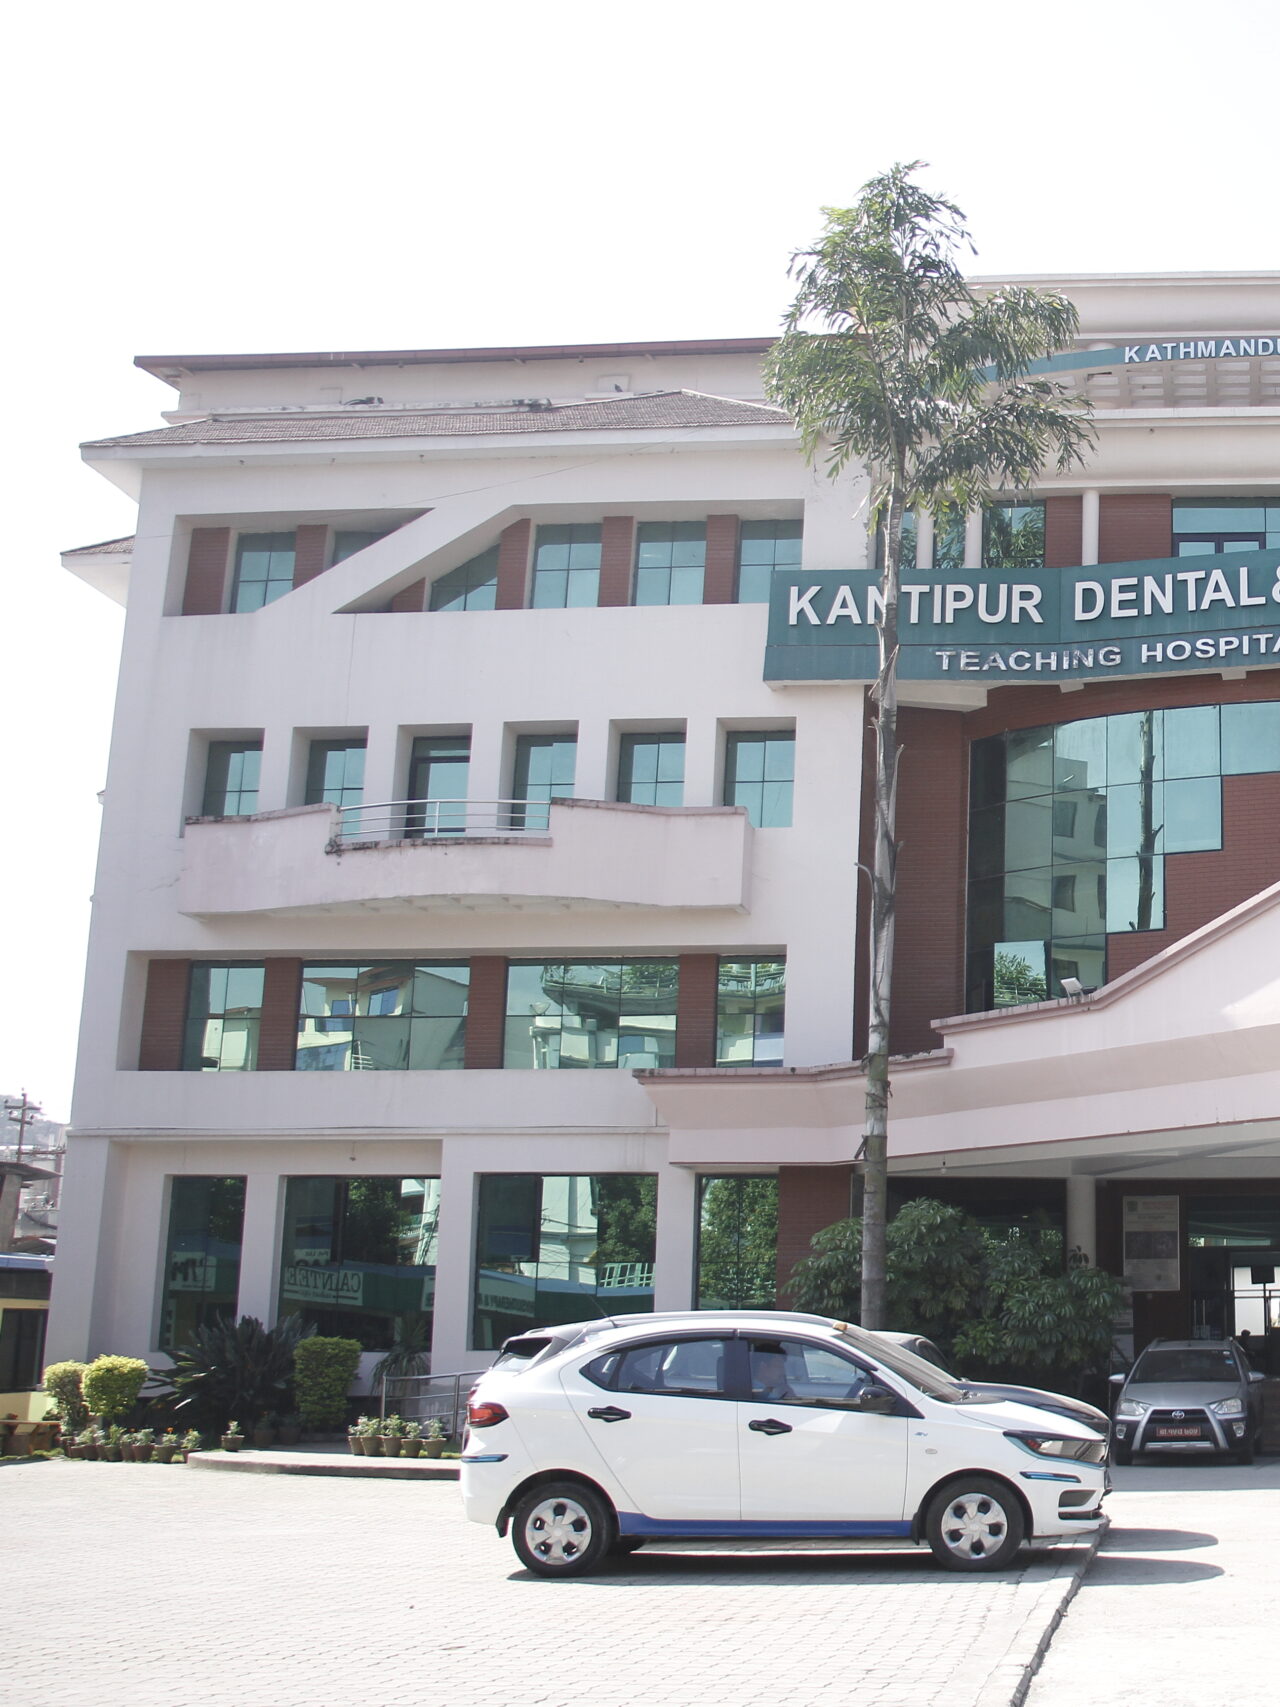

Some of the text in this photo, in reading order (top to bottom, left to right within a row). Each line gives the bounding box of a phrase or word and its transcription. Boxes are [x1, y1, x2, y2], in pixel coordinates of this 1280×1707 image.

[788, 583, 1044, 626] KANTIPUR
[1074, 566, 1266, 621] DENTAL
[935, 645, 1122, 672] TEACHING
